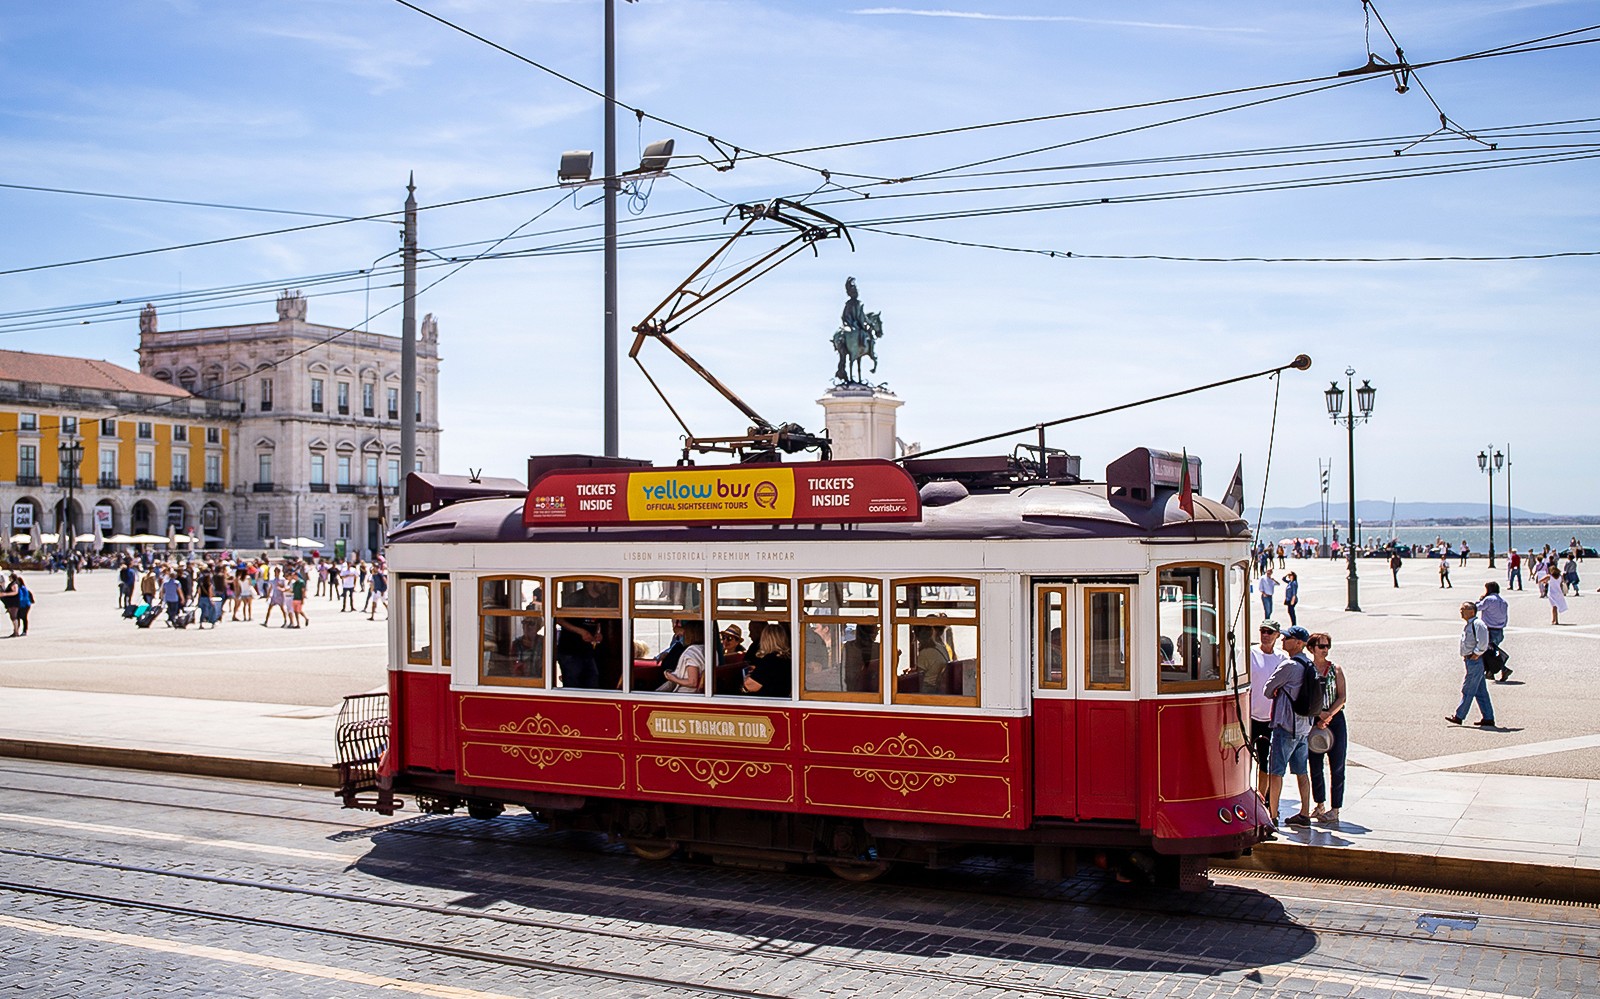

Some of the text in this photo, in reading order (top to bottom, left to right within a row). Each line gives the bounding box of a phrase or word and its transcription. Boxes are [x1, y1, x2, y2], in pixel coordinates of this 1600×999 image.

[576, 484, 617, 496] TICKETS
[642, 478, 751, 500] yellow bus
[807, 477, 855, 491] TICKETS
[579, 499, 613, 511] INSIDE
[646, 501, 749, 511] OFFICIAL SIGHTSEEING TOURS
[811, 494, 850, 507] INSIDE
[868, 504, 902, 513] carristur
[623, 551, 795, 561] LISBON HISTORICAL PREMIUM TRAMCAR
[654, 717, 768, 738] HILLS TRAMCAR TOUR
